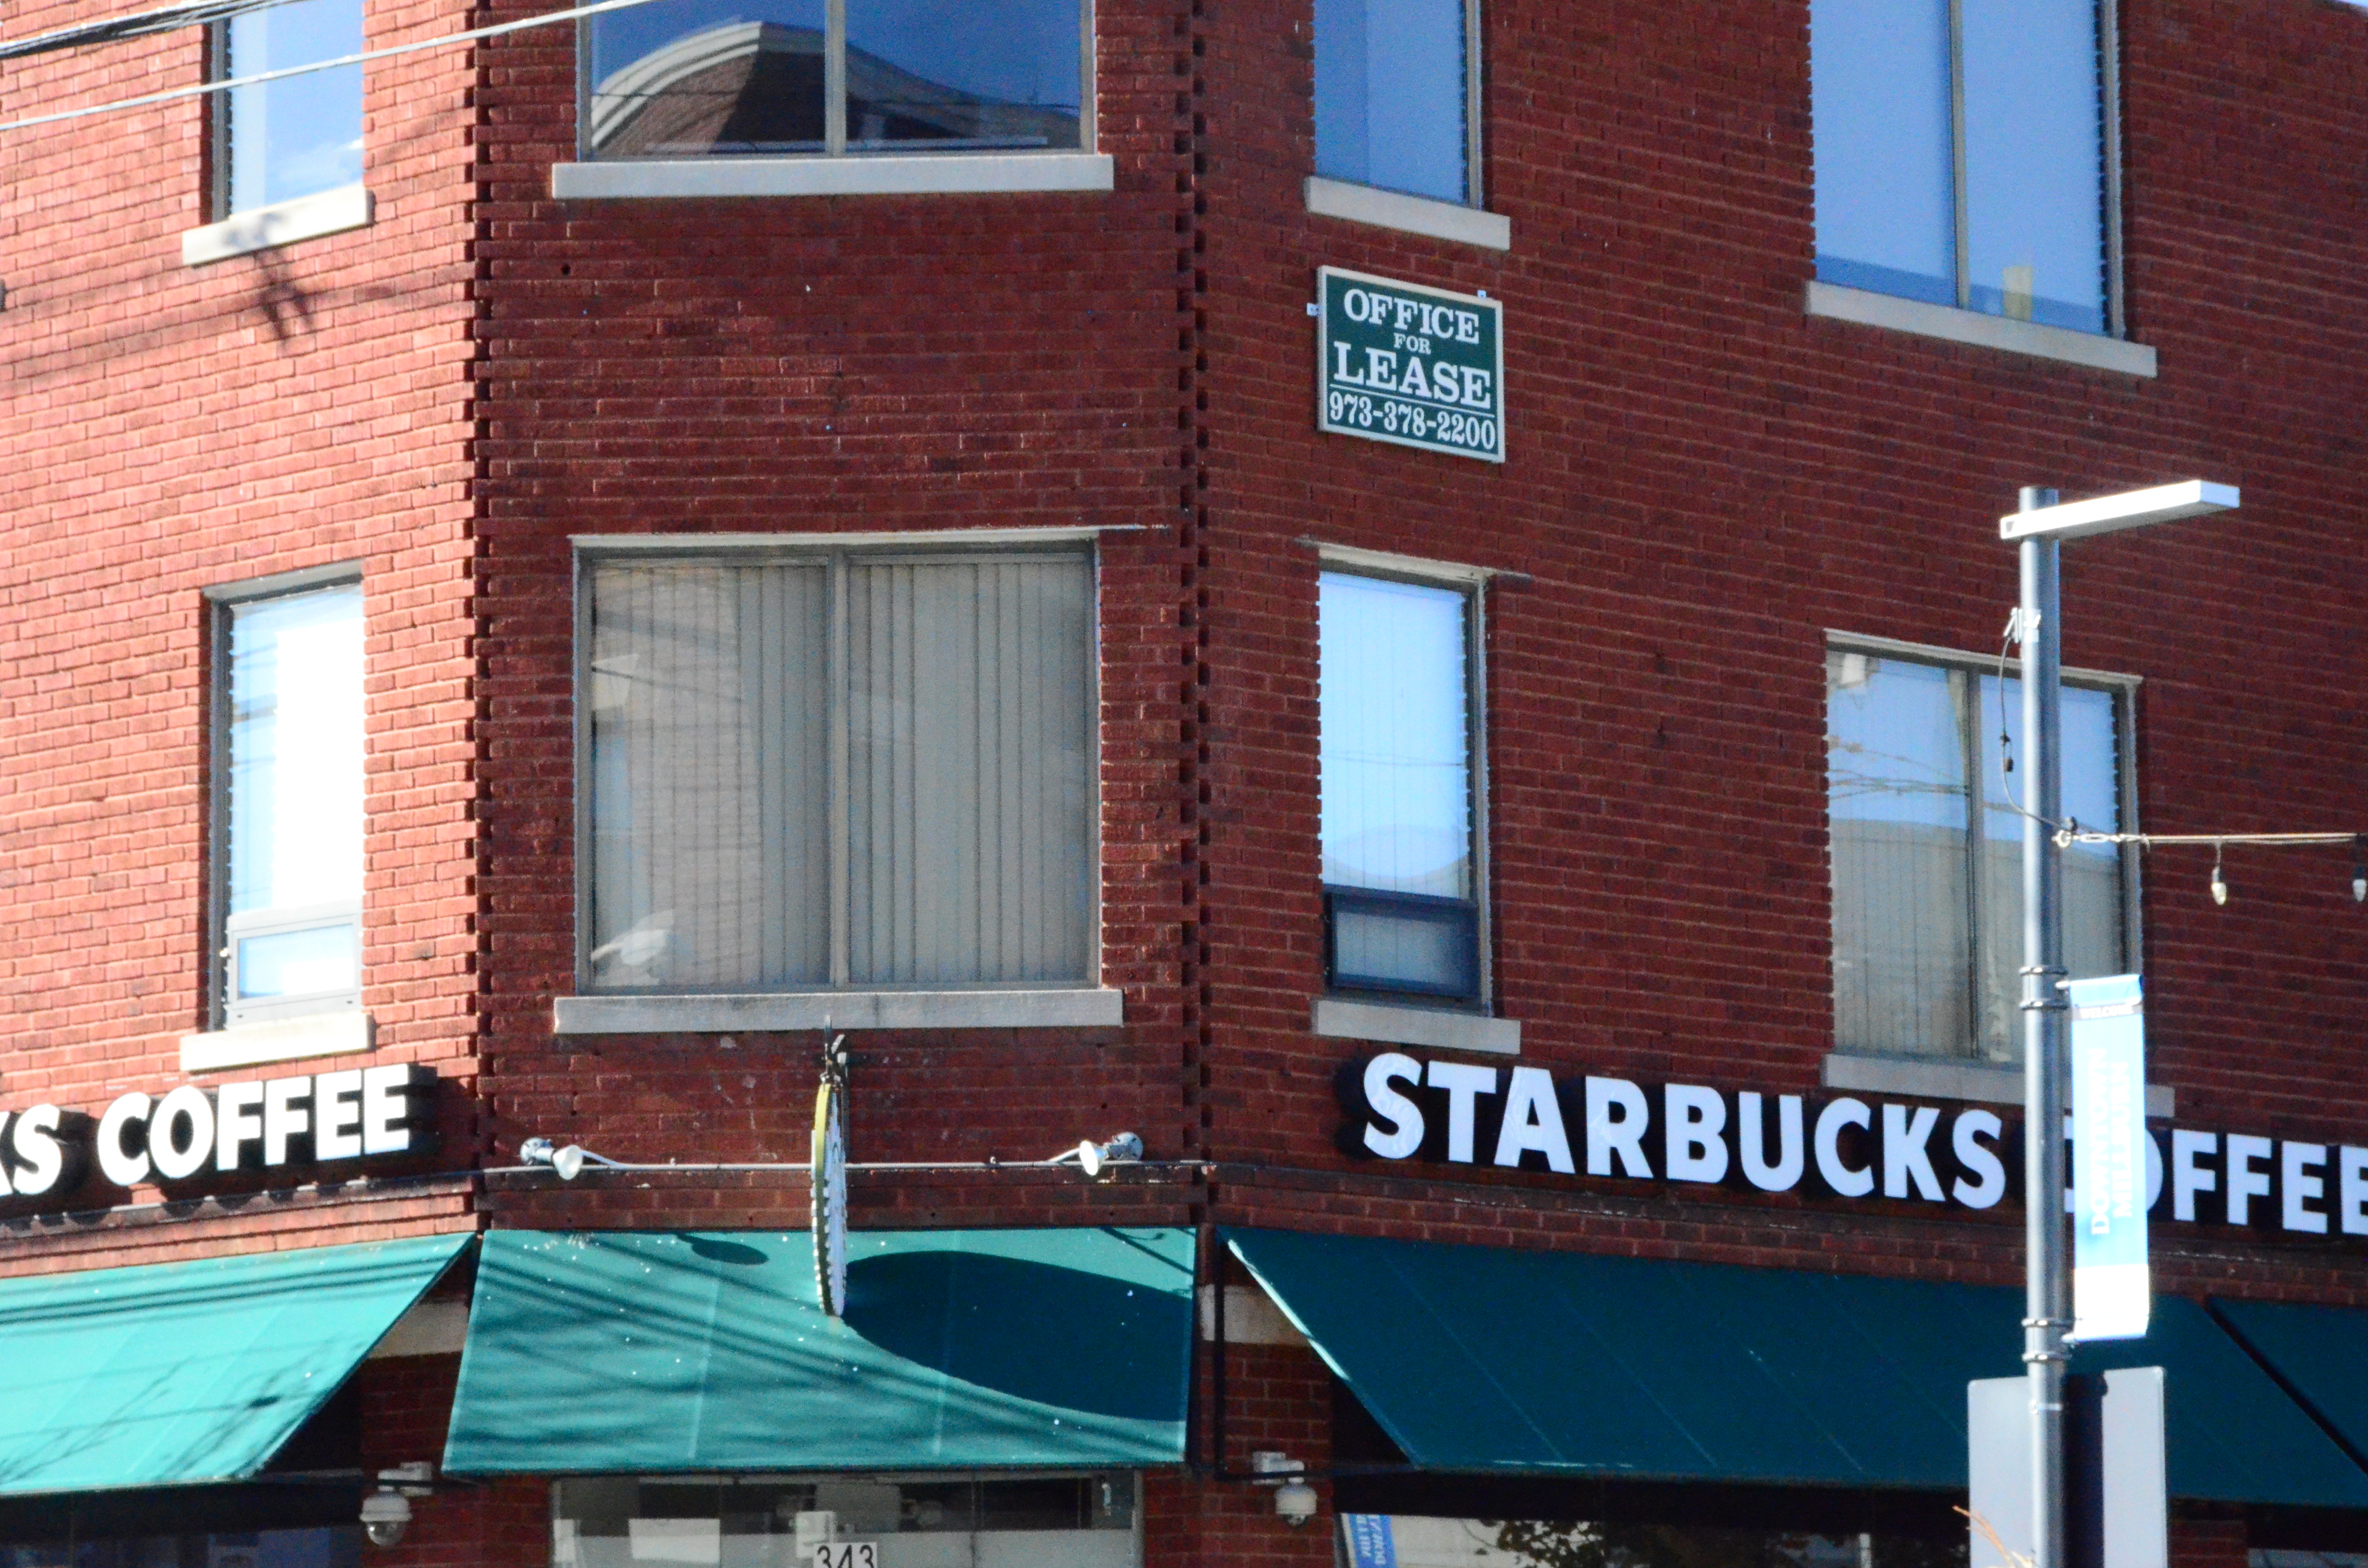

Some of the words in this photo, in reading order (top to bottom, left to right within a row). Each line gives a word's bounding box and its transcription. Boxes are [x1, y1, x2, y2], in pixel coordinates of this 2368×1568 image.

[1344, 288, 1480, 344] OFFICE
[1394, 333, 1431, 355] FOR
[1333, 341, 1491, 409] LEASE
[1329, 391, 1495, 450] 973-378-2200
[2080, 1003, 2134, 1019] WELCOME
[0, 1103, 63, 1196] S
[98, 1063, 410, 1186] COFFEE
[1363, 1052, 2006, 1209] STARBUCKS
[2064, 1115, 2368, 1235] FFEE
[2087, 1048, 2110, 1235] DOWNTOWN
[2109, 1061, 2133, 1218] MILLBURN
